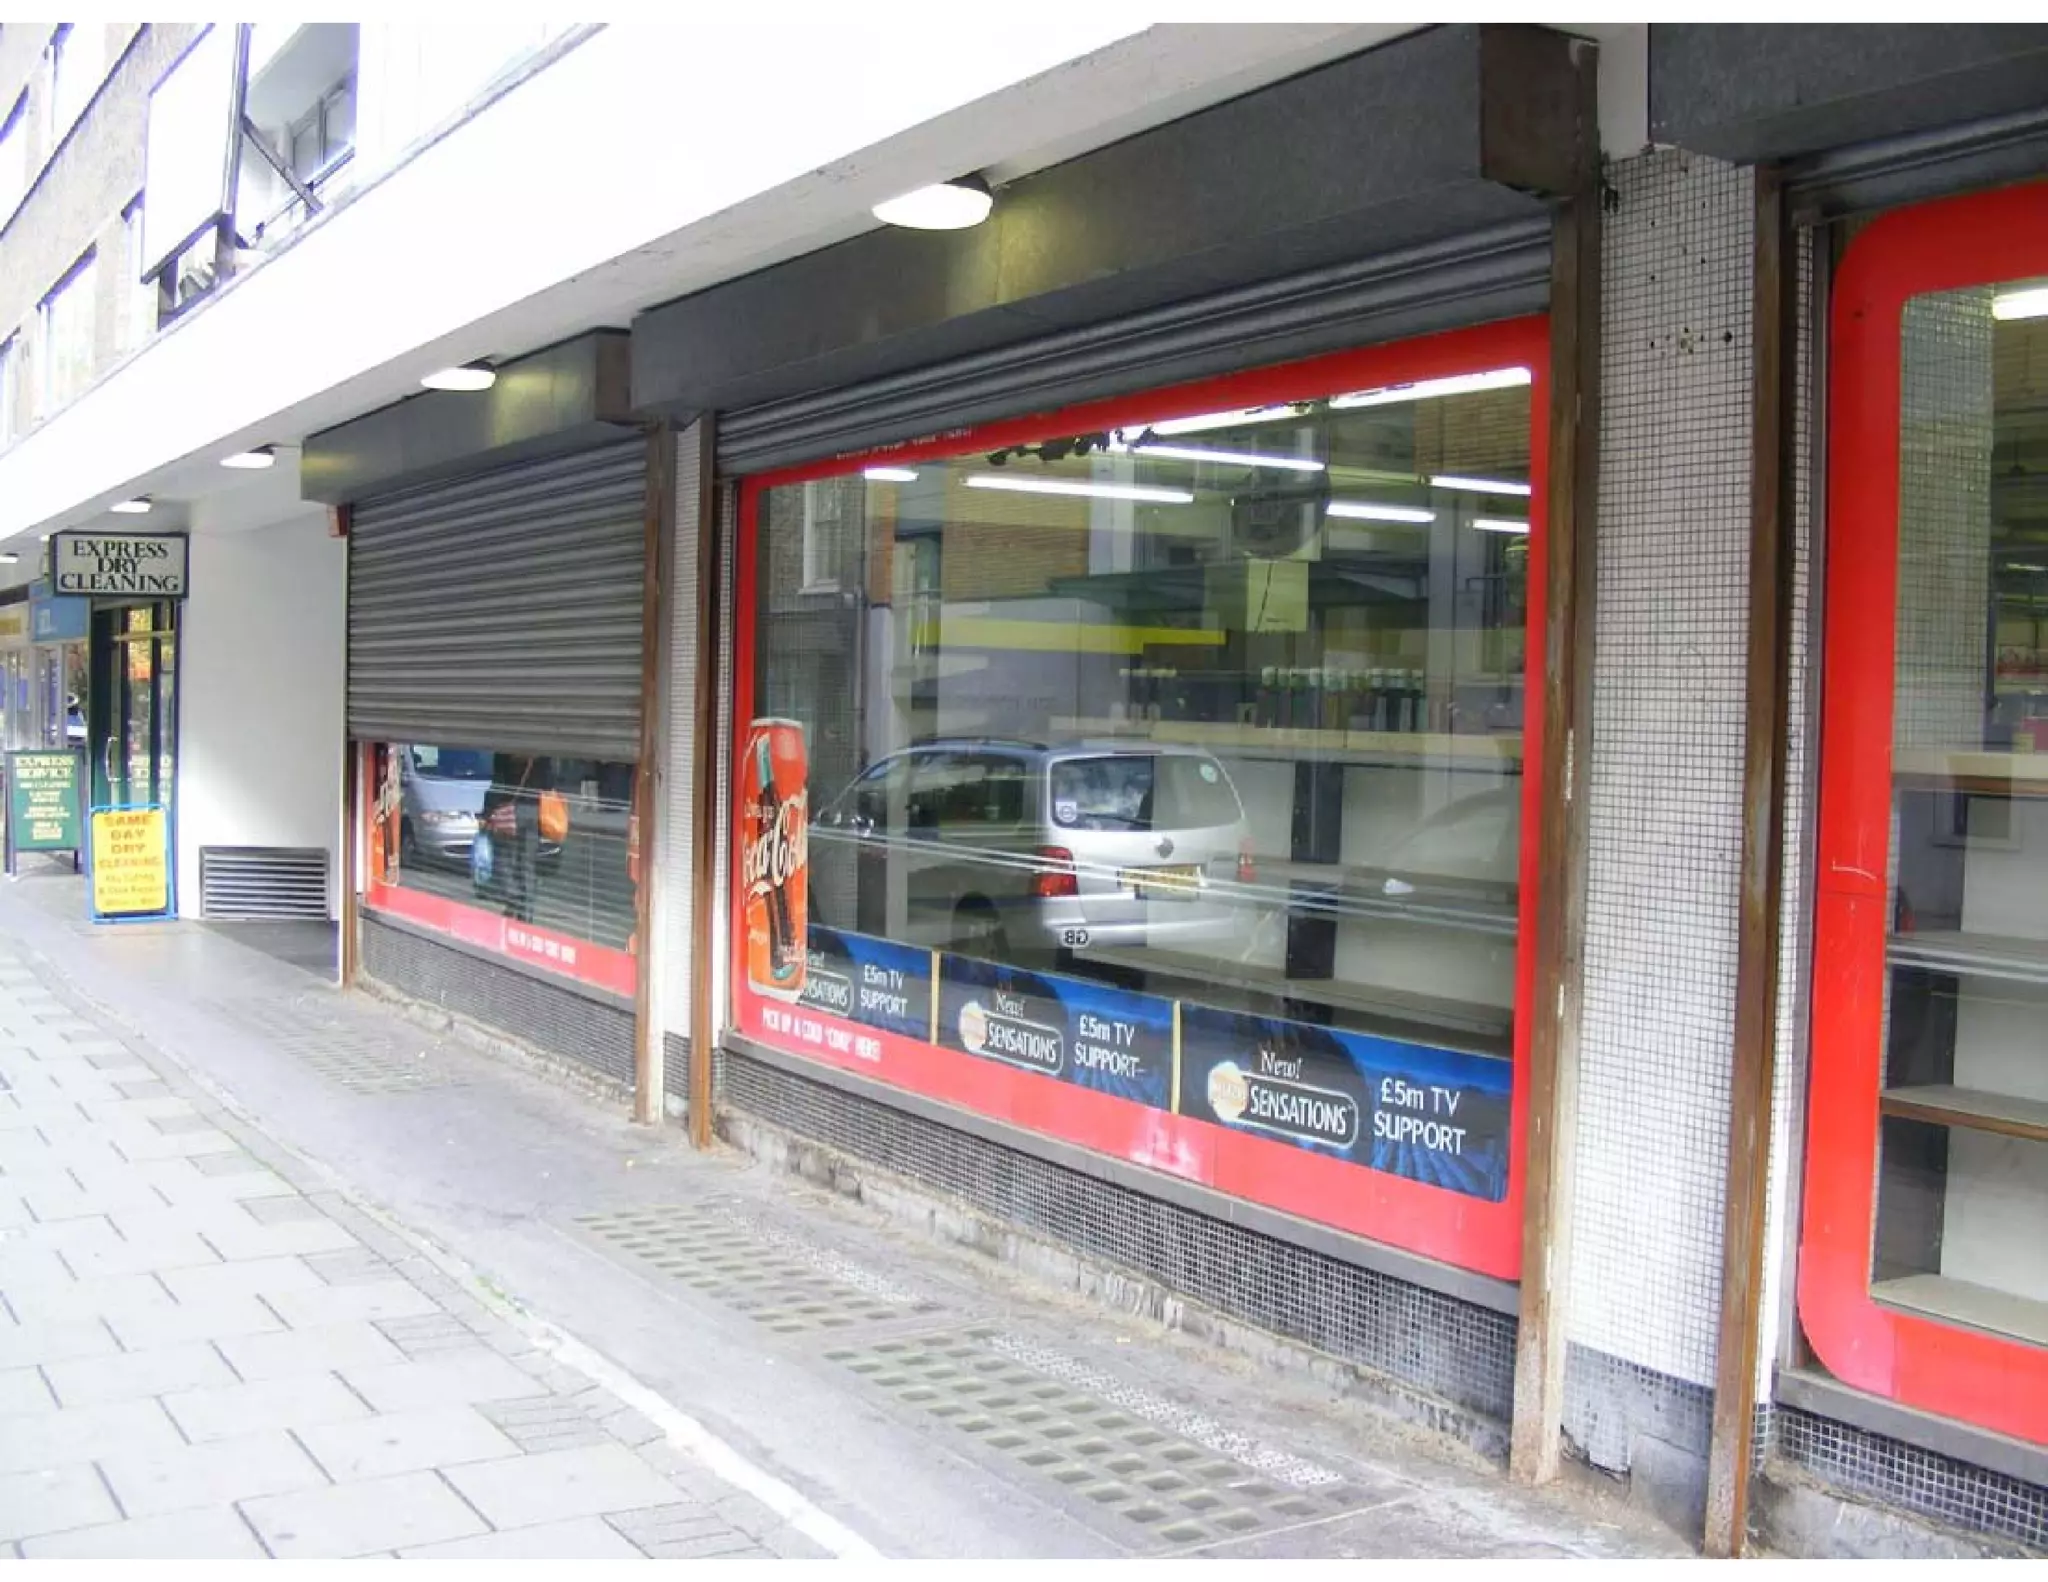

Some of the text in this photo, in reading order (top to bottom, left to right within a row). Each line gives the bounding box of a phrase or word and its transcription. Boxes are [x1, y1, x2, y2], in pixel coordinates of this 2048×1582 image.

[73, 540, 169, 558] EXPRESS
[60, 573, 179, 592] CLEANING
[97, 558, 142, 576] DRY
[110, 828, 146, 842] DAY
[110, 843, 146, 855] DRY
[889, 967, 905, 991] TV
[860, 987, 908, 1018] SUPPORT
[987, 1021, 1057, 1064] SENSATIONS
[1079, 1014, 1135, 1047] £5m TV
[1074, 1040, 1141, 1079] SUPPORT
[1260, 1048, 1304, 1080] New!
[1249, 1084, 1347, 1136] SENSATIONS
[1380, 1077, 1462, 1117] £5m TV
[1374, 1108, 1467, 1156] SUPPORT
